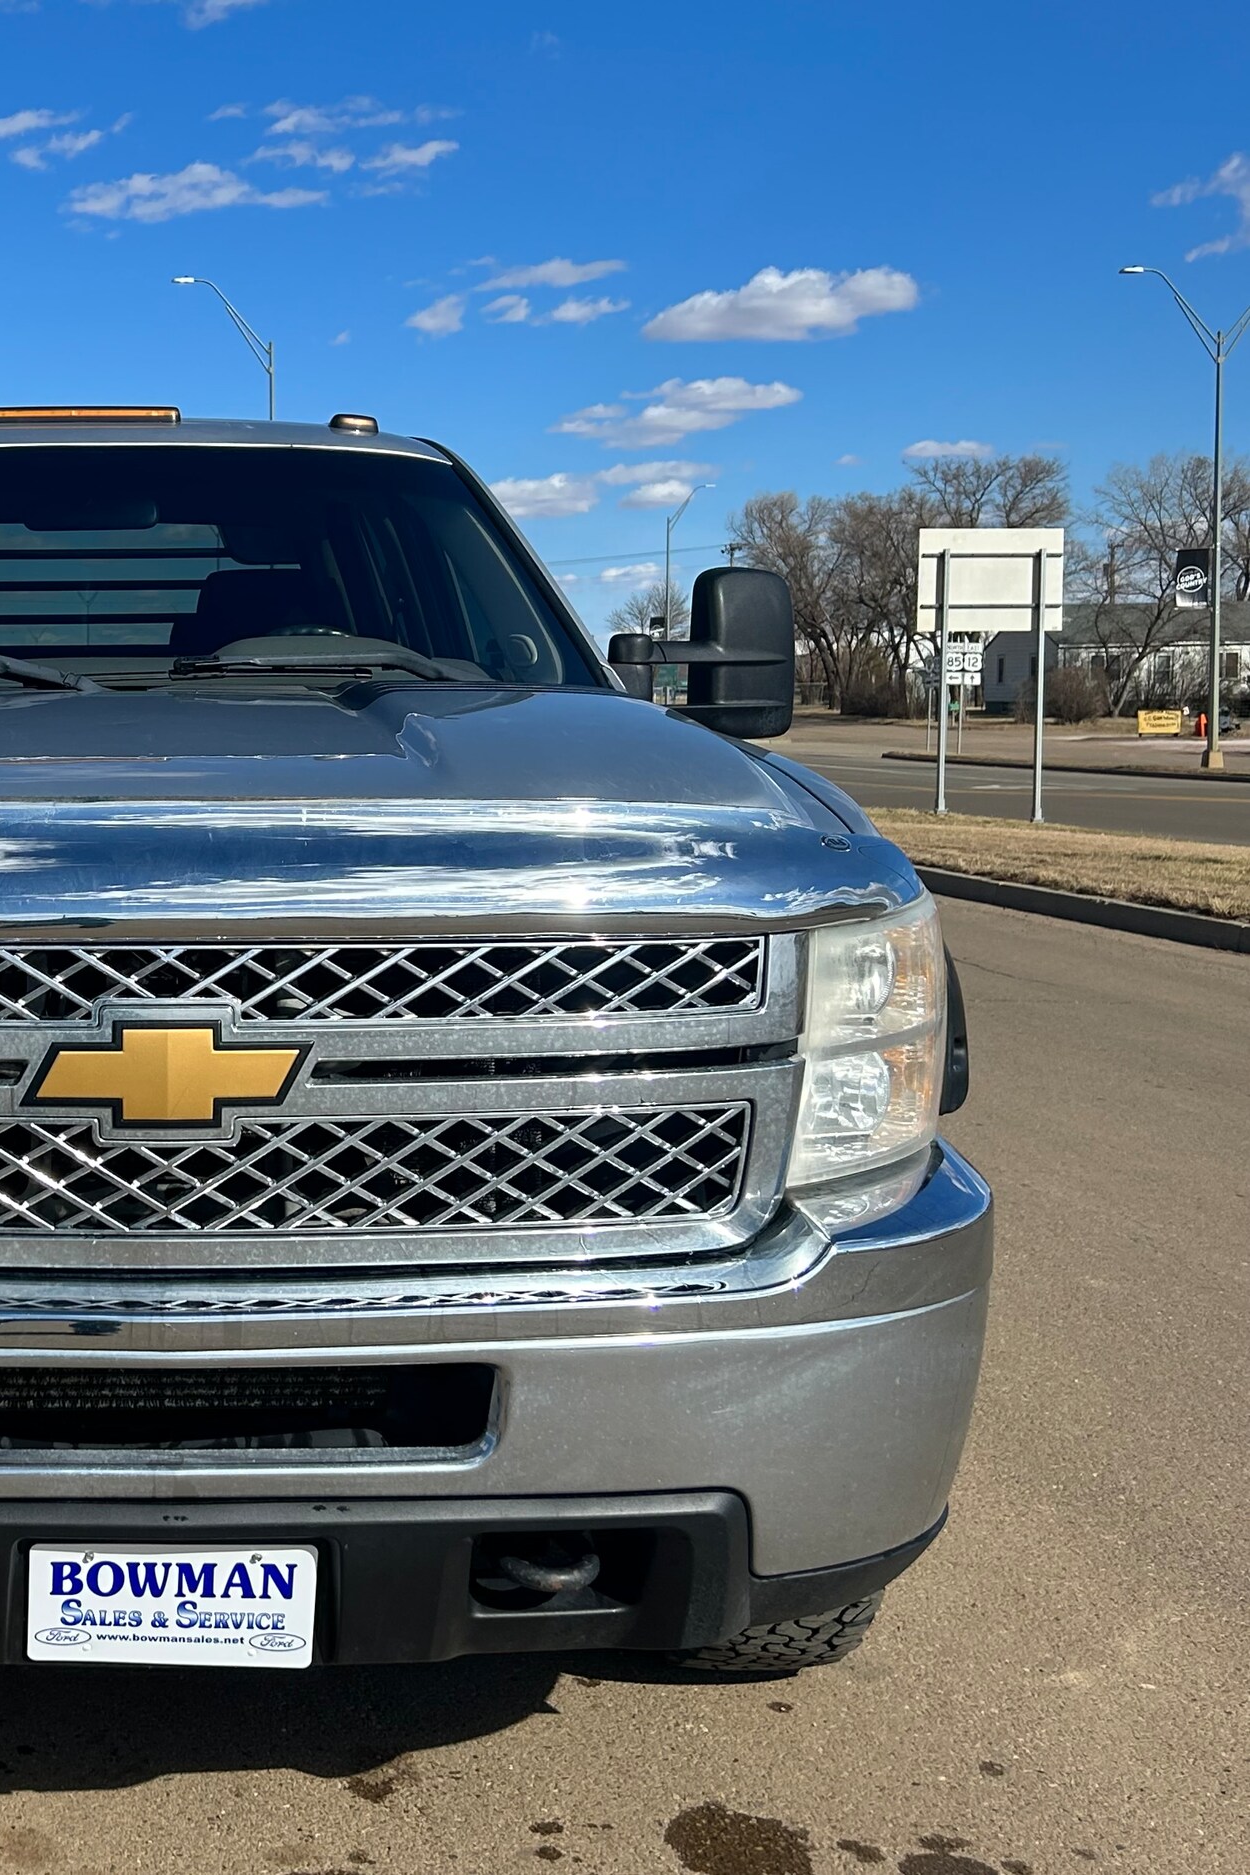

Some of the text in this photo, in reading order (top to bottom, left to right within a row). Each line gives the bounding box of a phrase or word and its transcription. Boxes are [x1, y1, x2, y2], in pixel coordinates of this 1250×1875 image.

[947, 656, 962, 668] 85
[967, 656, 978, 668] 12
[50, 1561, 298, 1599] BOWMAN
[60, 1598, 286, 1630] SALES & SERVICE
[45, 1629, 80, 1642] Ford
[96, 1633, 245, 1645] www.bowmansales.net
[260, 1634, 294, 1648] Ford
